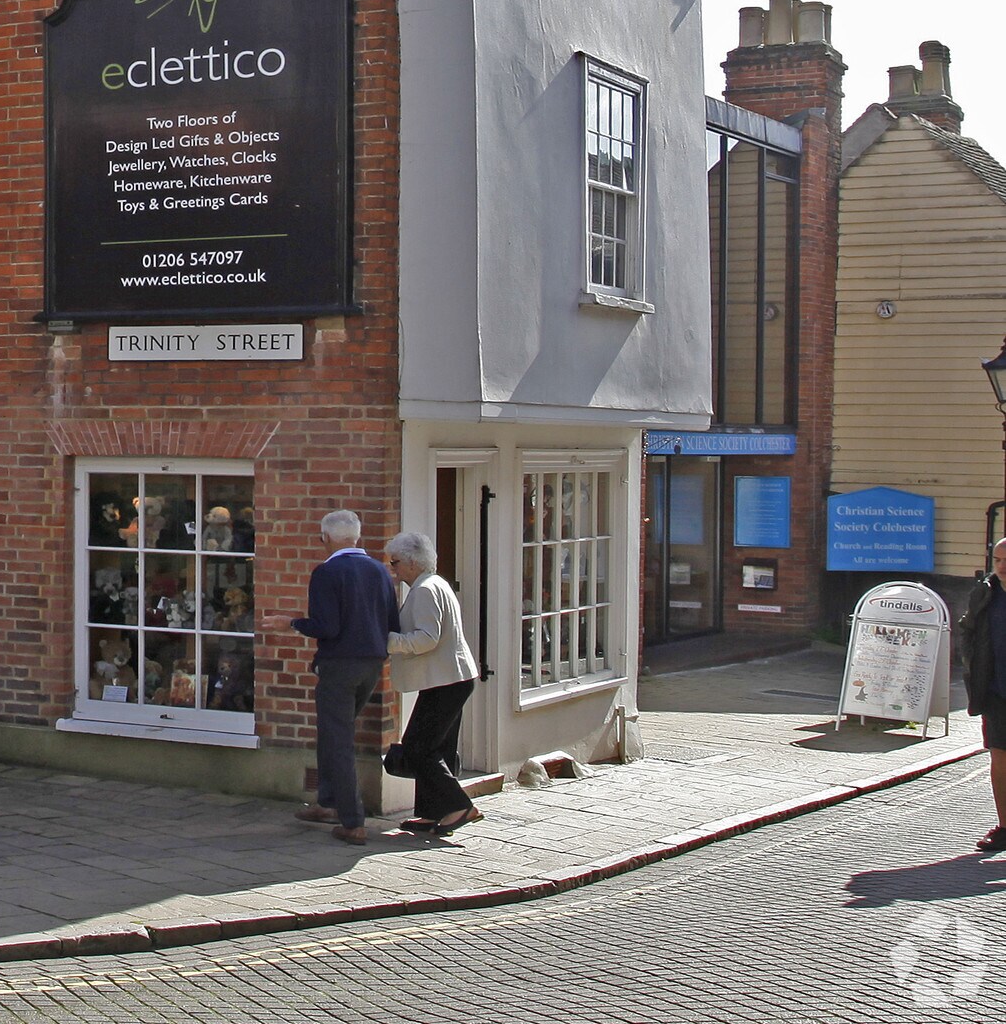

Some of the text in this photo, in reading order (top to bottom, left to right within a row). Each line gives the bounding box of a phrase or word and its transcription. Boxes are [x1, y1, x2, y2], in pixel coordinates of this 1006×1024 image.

[101, 40, 286, 90] eclettico
[146, 111, 237, 130] Two Floors of
[105, 130, 280, 154] Design Led Gifts & Objects
[107, 150, 277, 176] Jewellery, Watches, Clocks
[114, 173, 272, 193] Homeware, Kitchenware
[117, 191, 268, 215] Toys & Greetings Cards
[142, 250, 243, 268] 01206 547097
[121, 268, 267, 287] www.eclettico.co.uk
[115, 333, 295, 351] TRINITY STREET
[686, 436, 716, 450] SCIENCE
[719, 436, 748, 450] SOCIETY
[749, 437, 791, 451] COLCHESTER
[836, 506, 924, 516] Christian Science
[834, 522, 926, 534] Society Colchester
[834, 542, 861, 550] Church
[874, 543, 904, 551] Reading
[880, 600, 923, 612] tindalls
